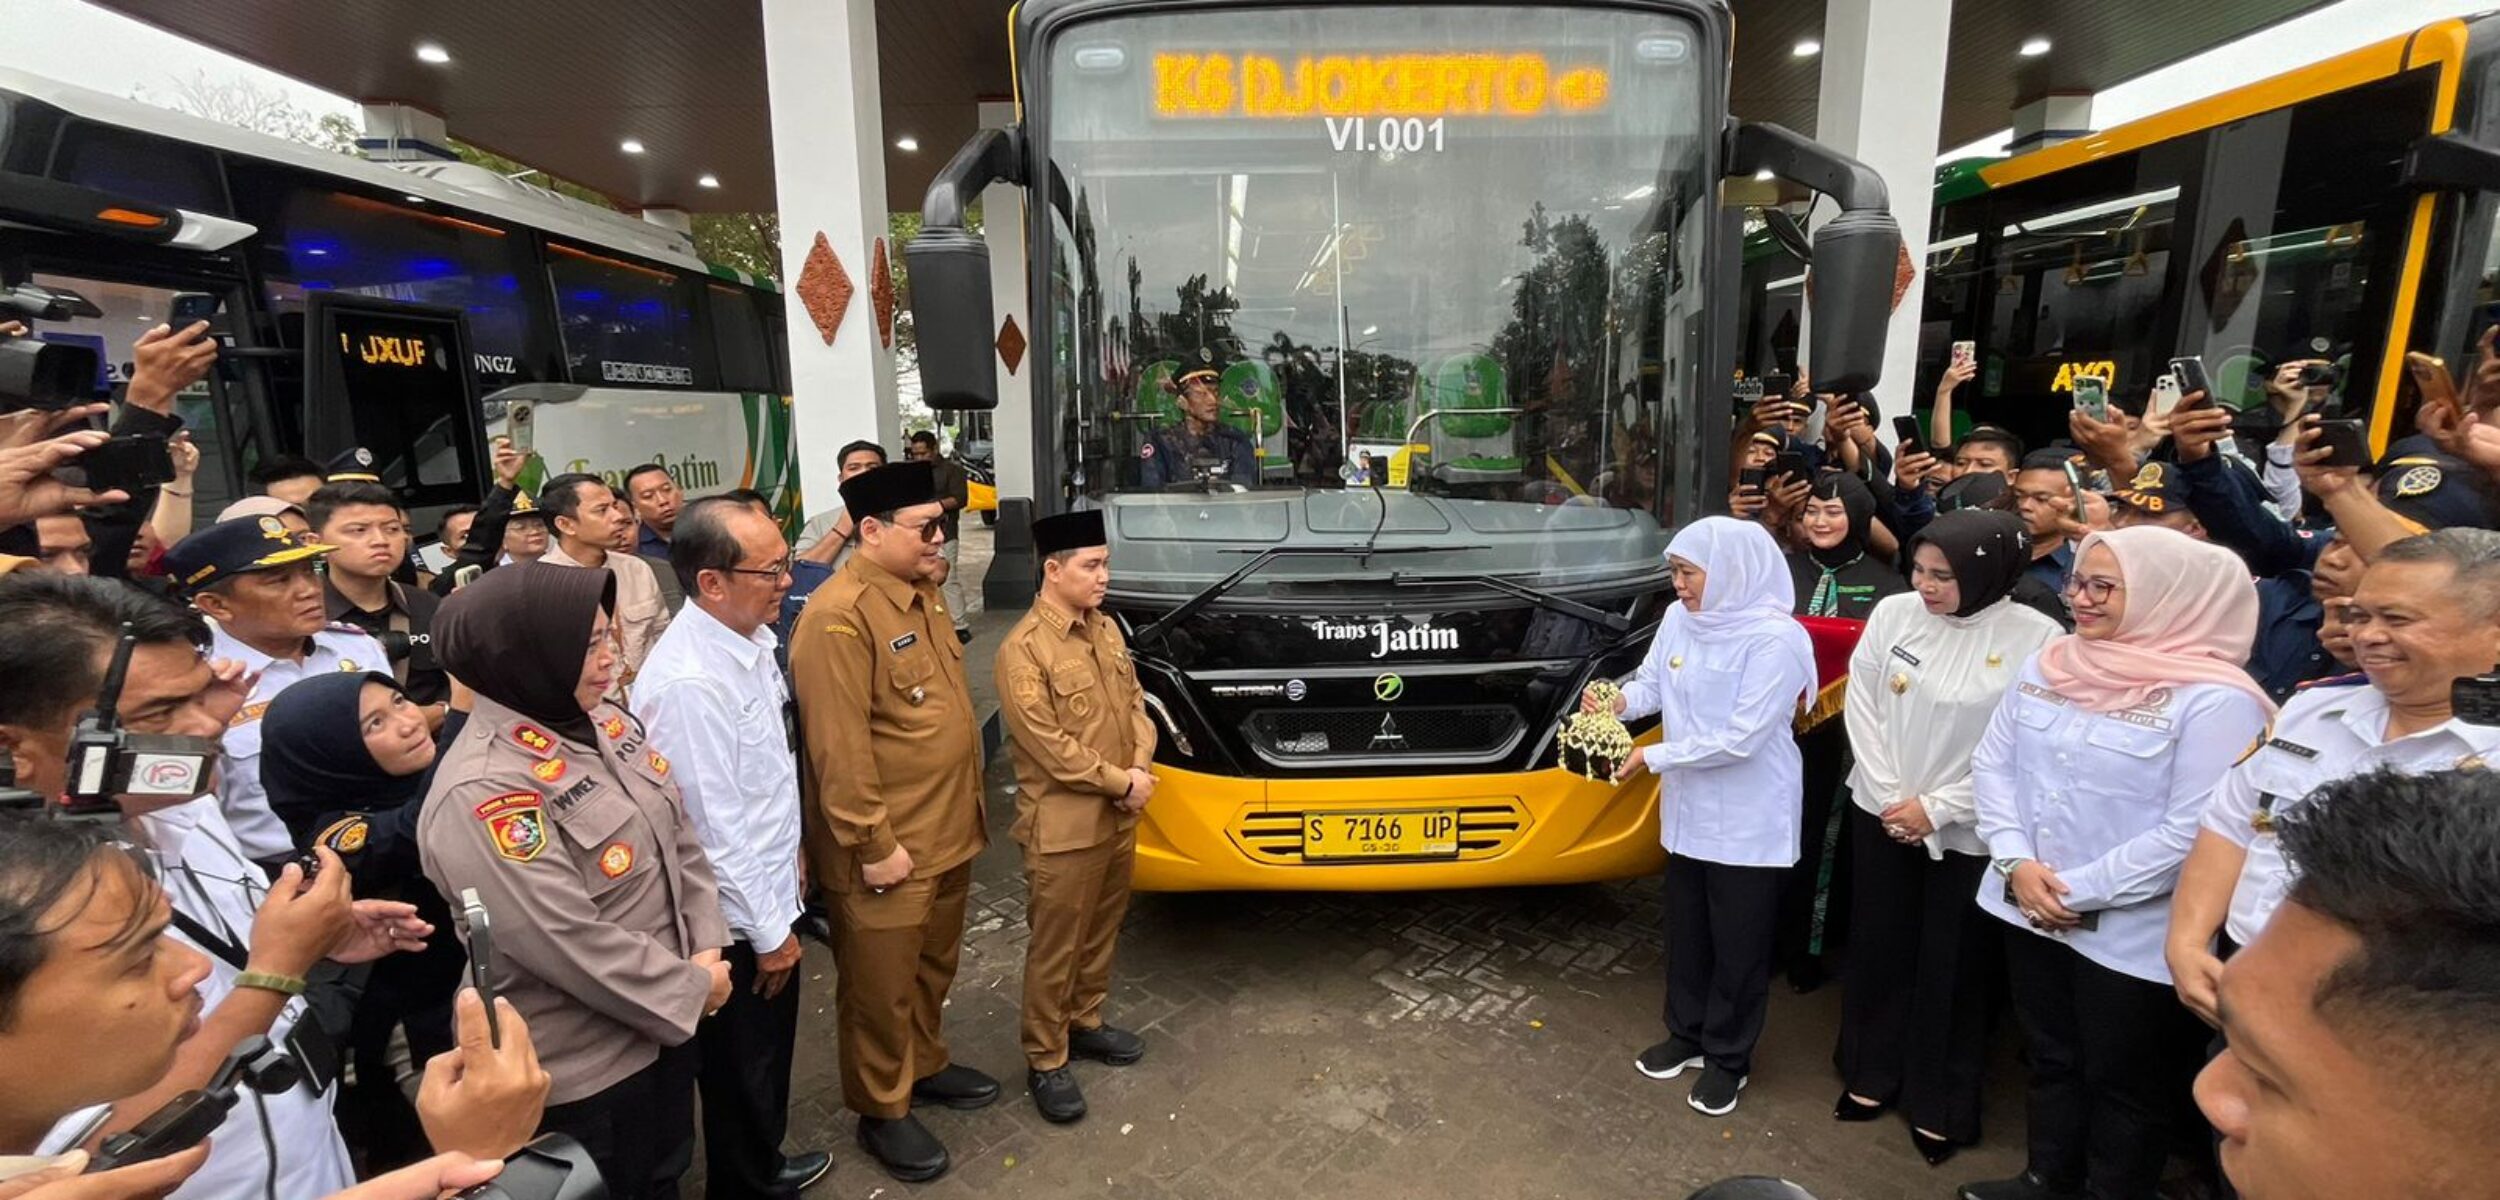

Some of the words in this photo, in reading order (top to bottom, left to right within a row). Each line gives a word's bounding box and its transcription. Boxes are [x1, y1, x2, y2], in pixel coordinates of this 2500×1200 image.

[1154, 53, 1234, 115] K6
[1242, 52, 1548, 115] DJOKERTO
[1325, 117, 1445, 151] VI.001
[1311, 620, 1367, 640] Trans
[1370, 622, 1459, 658] Jatim
[1310, 819, 1323, 841] S
[1345, 817, 1402, 841] 7166
[1423, 816, 1452, 839] UP
